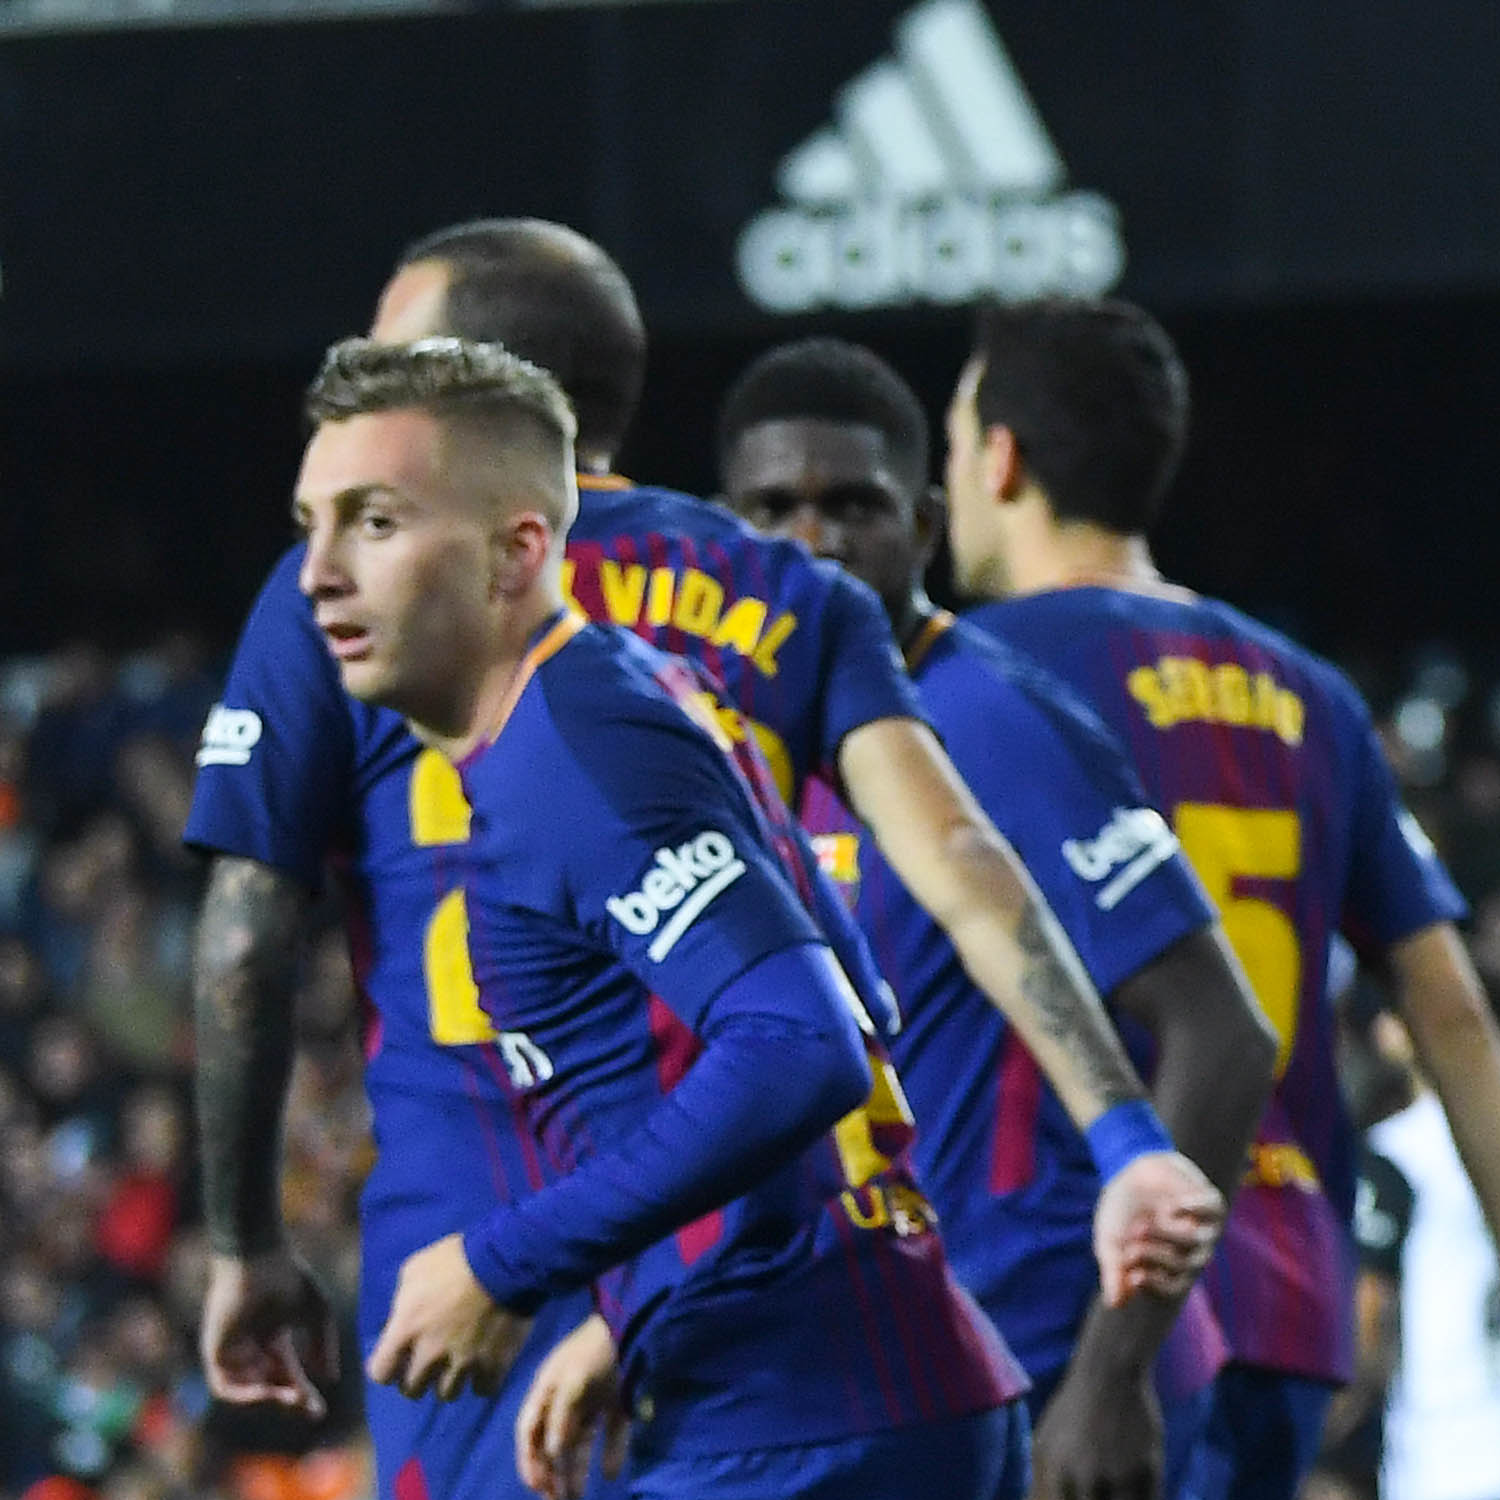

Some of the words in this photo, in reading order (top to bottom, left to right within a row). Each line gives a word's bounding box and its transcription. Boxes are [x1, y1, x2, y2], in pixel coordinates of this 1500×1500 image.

[602, 559, 798, 679] VIDAL
[605, 830, 736, 935] beko
[1173, 802, 1301, 1080] 5
